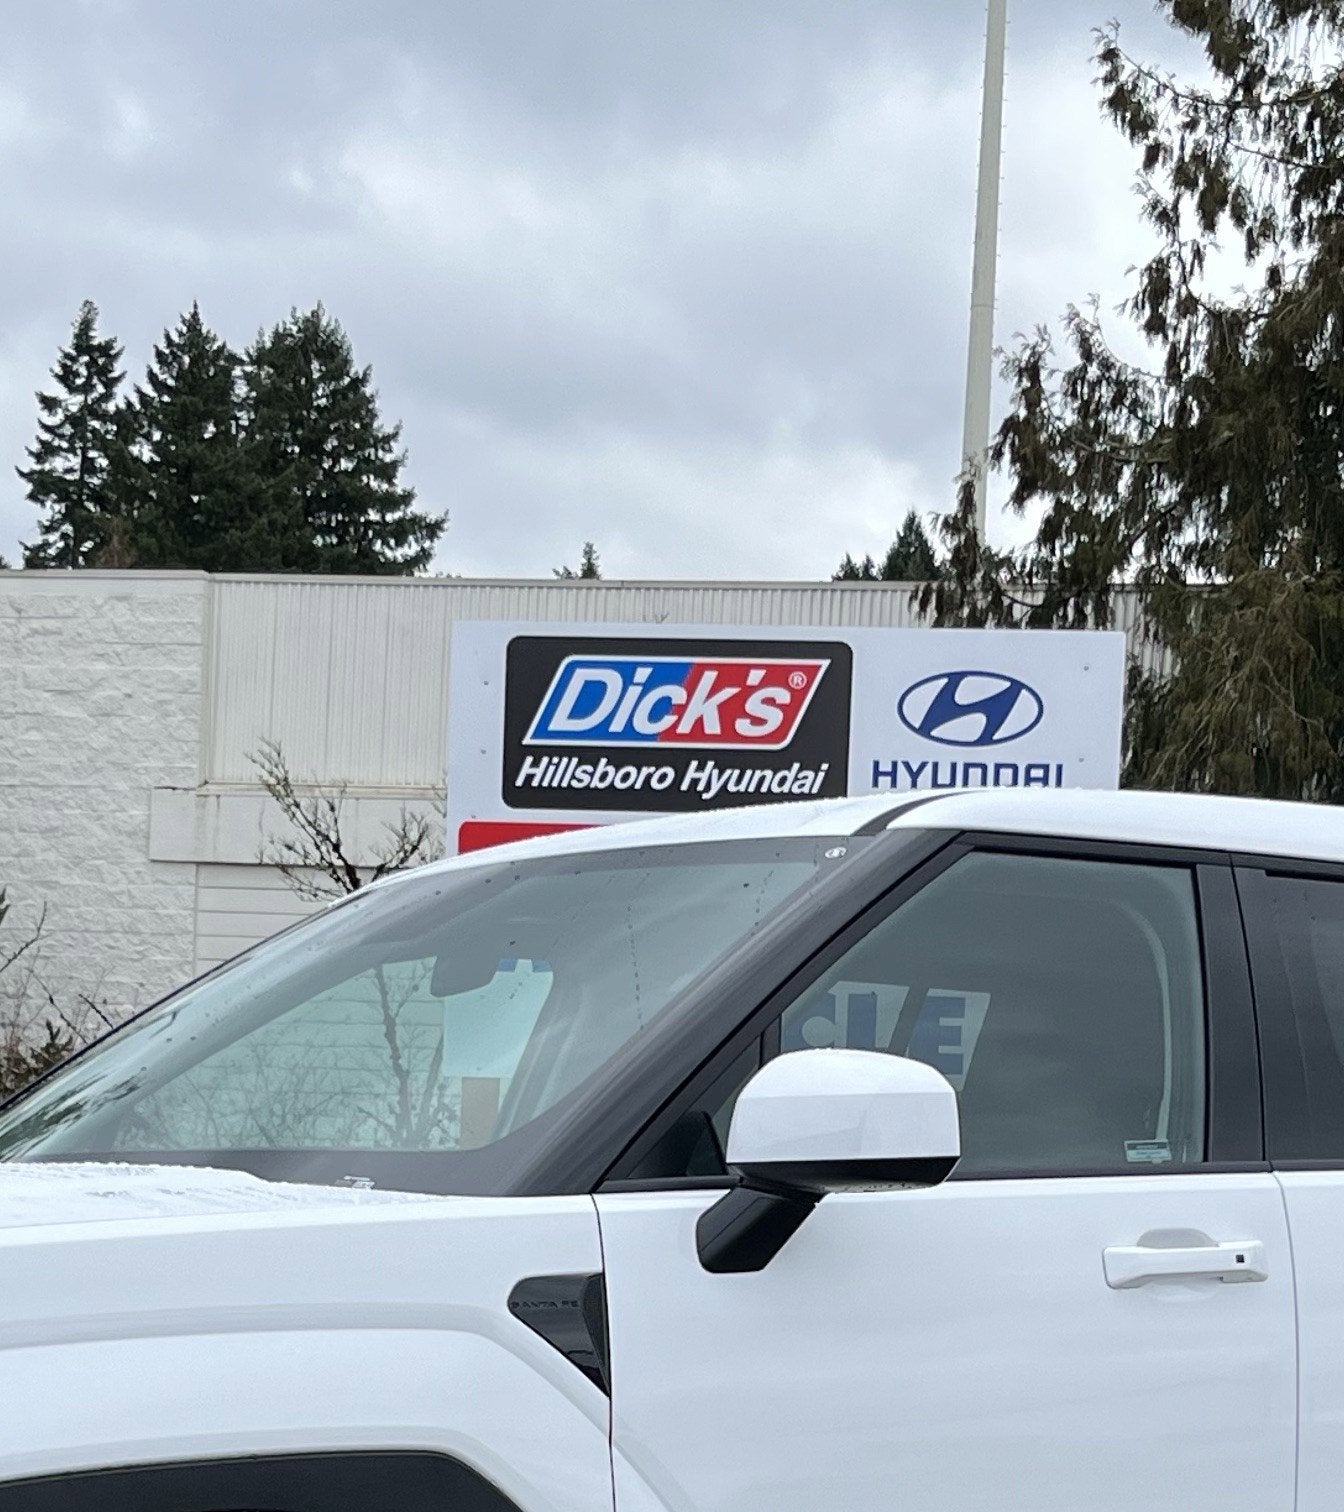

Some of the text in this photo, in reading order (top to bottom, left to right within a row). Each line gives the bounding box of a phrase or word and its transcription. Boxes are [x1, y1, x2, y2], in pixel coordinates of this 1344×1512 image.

[514, 756, 829, 800] Hillsboro Hyundai
[872, 760, 1063, 789] HYUNDAI
